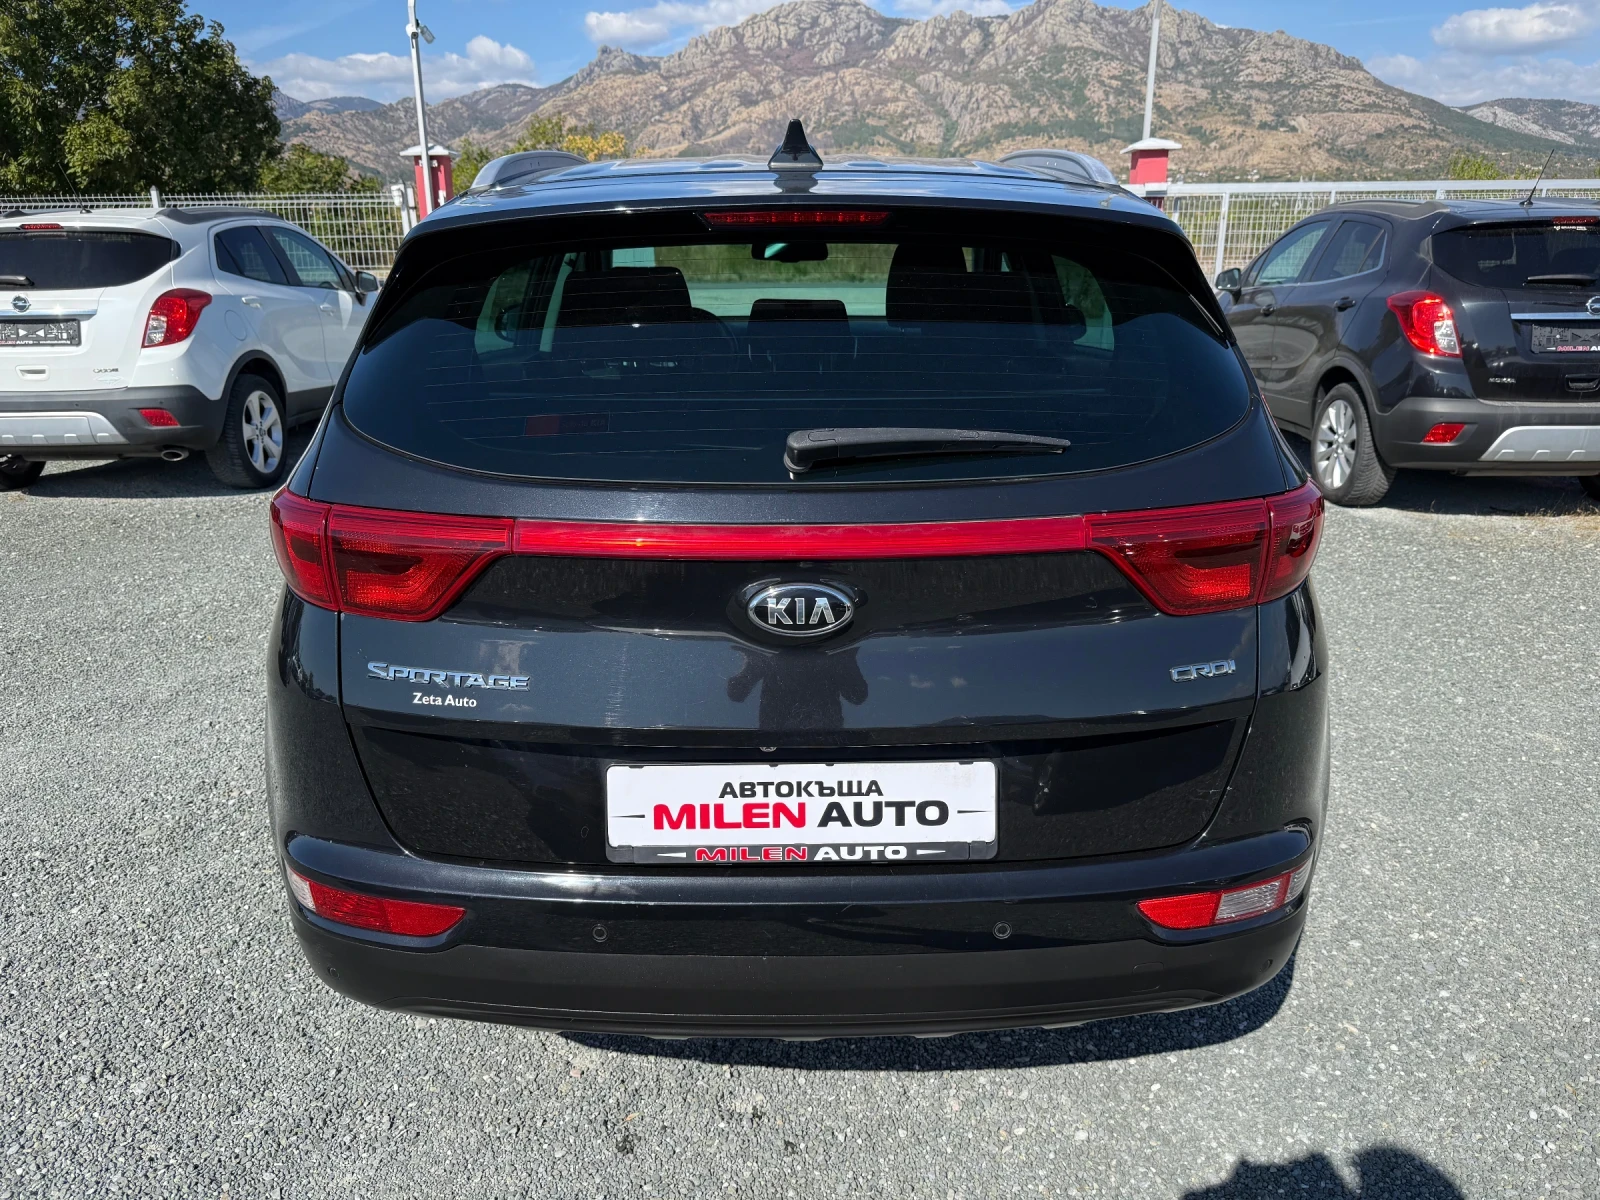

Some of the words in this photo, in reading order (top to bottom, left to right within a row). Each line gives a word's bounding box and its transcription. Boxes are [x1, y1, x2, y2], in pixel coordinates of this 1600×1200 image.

[766, 597, 836, 625] KIA
[367, 661, 532, 692] SPORTAGE
[412, 692, 443, 706] Zeta
[444, 694, 478, 708] Auto
[652, 801, 806, 831] MILEN
[816, 799, 950, 829] AUTO
[694, 846, 808, 862] MILEN
[812, 844, 908, 861] AUTO
